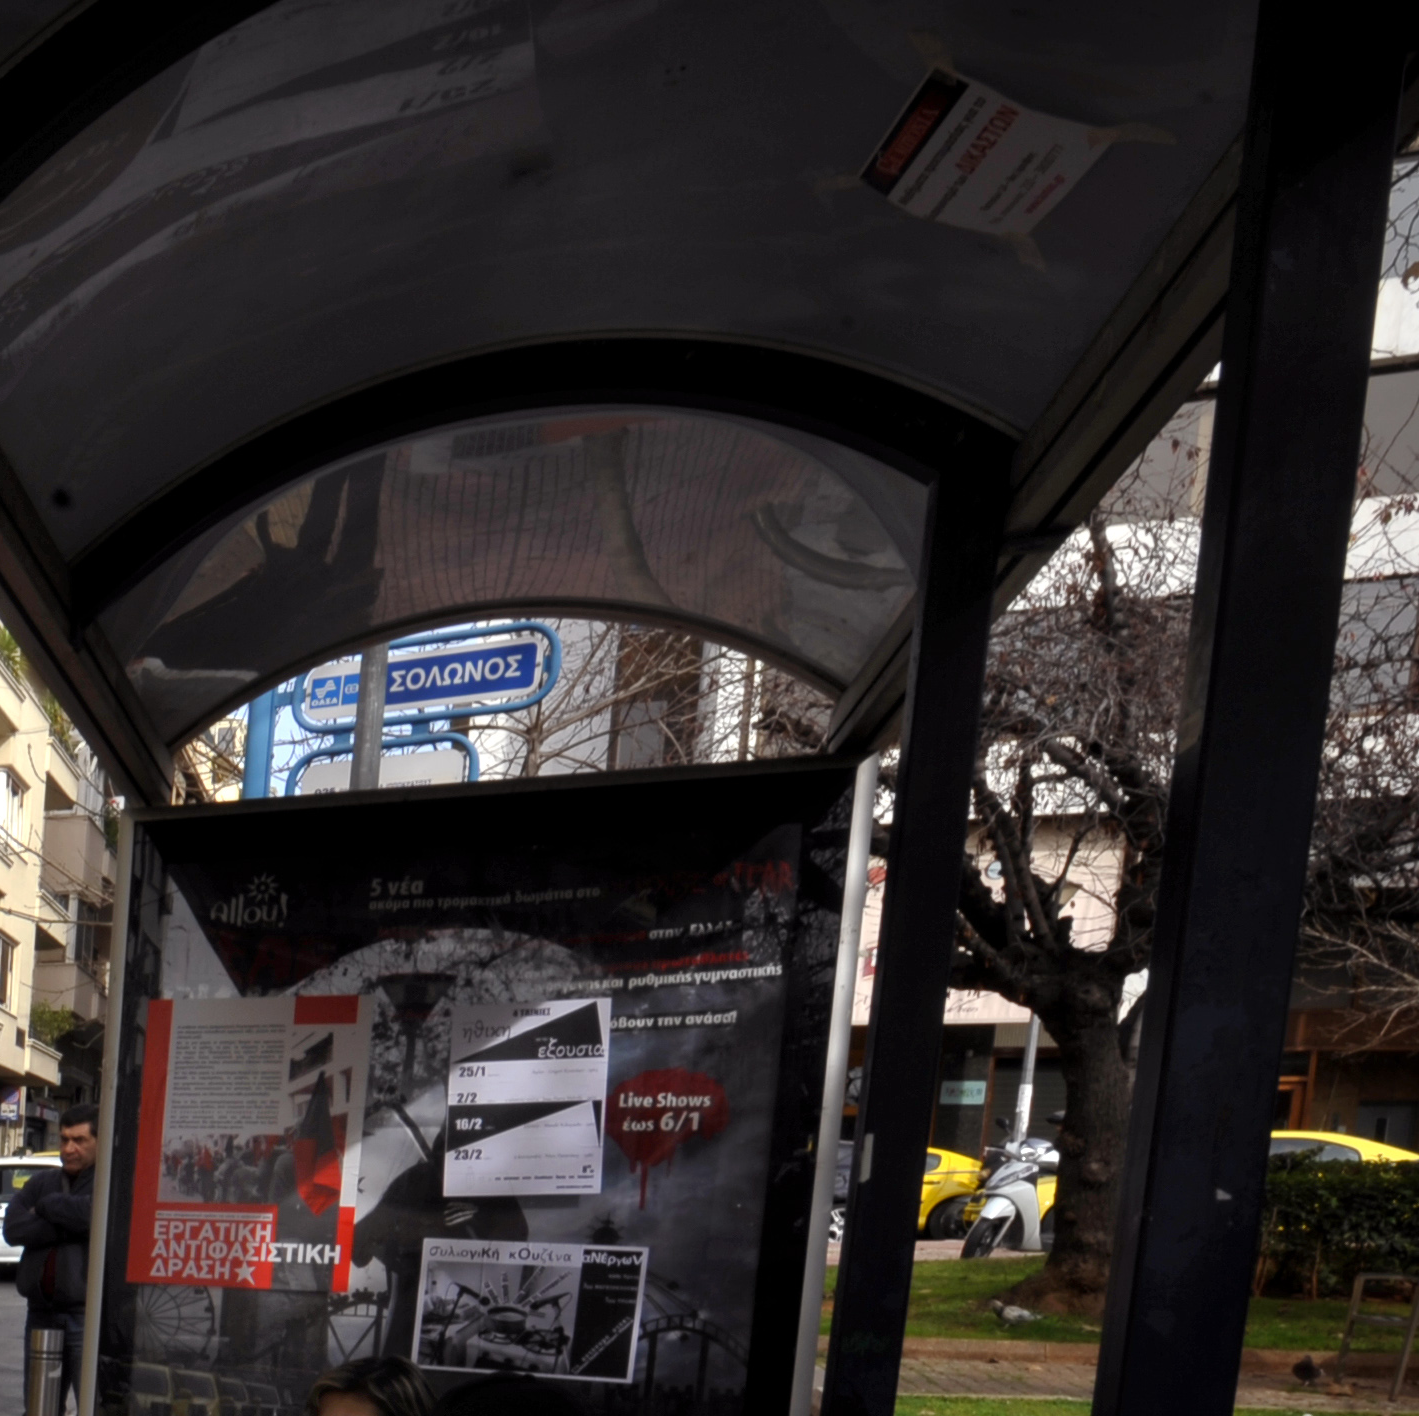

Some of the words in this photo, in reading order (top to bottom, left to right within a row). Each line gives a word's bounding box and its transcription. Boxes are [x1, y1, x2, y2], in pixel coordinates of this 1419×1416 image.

[389, 654, 523, 693] ΣΟΛΩΝΟΣ
[370, 878, 383, 897] 5
[388, 876, 425, 897] νέα
[369, 898, 409, 911] ακόμα
[412, 897, 434, 910] πιο
[515, 886, 573, 903] δωμάτια
[693, 963, 782, 986] γυμναστικής
[657, 1017, 681, 1028] την
[459, 1066, 487, 1078] 25/1
[457, 1092, 478, 1104] 2/2
[618, 1091, 653, 1108] Live
[656, 1092, 711, 1108] Shows
[455, 1118, 483, 1131] 16/2
[660, 1111, 700, 1132] 6/1
[454, 1149, 483, 1161] 23/2
[154, 1221, 272, 1243] ΕΡΓΑΤΙΚΗ
[151, 1240, 341, 1265] ΑΝΤΙΦΑΣΙΣΤΙΚΗ
[149, 1259, 231, 1280] ΔΡΑΣΗ
